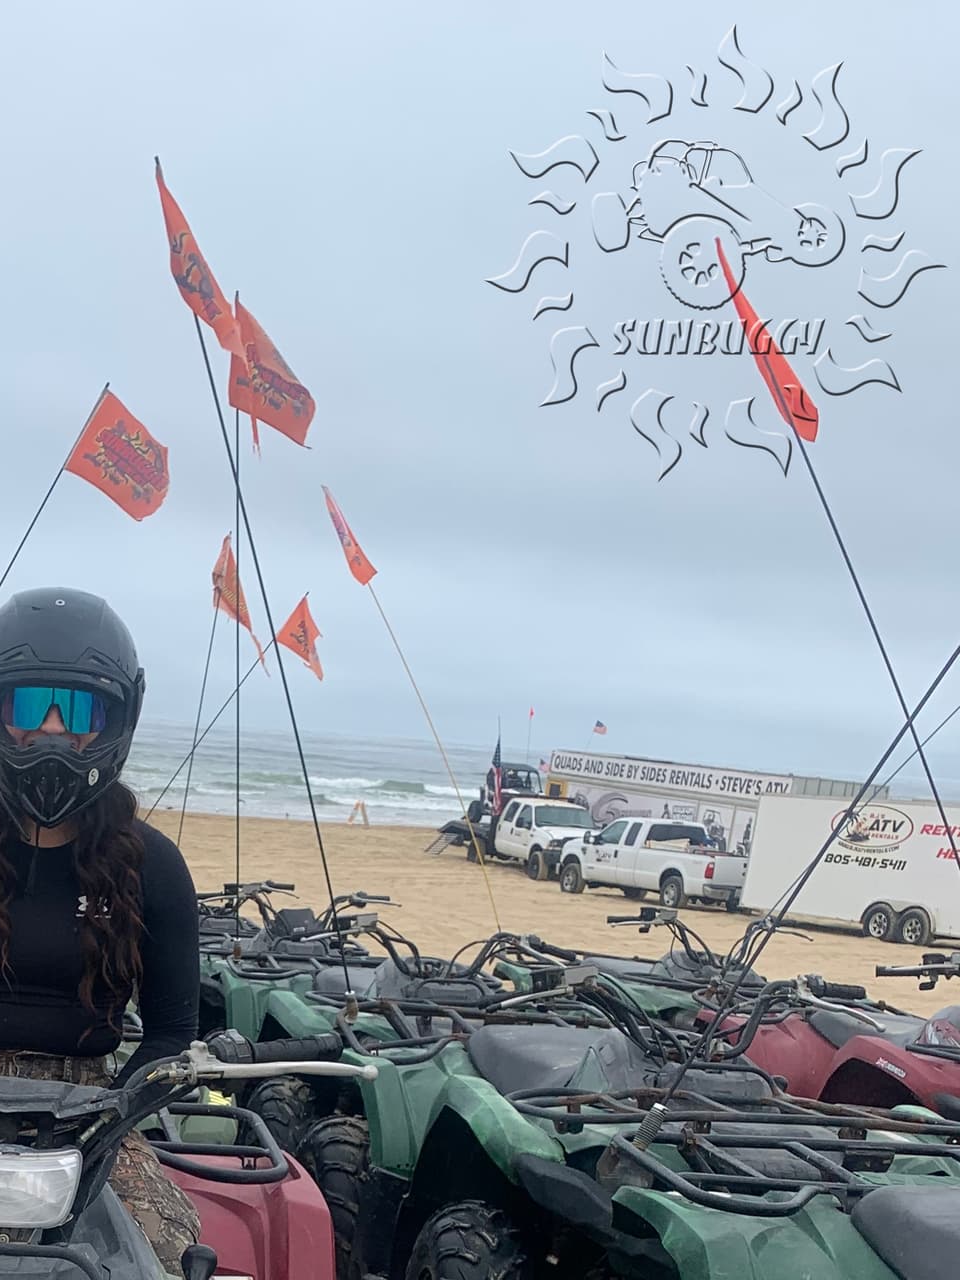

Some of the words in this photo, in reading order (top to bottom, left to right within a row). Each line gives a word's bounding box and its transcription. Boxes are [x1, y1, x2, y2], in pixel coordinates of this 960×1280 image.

[554, 754, 583, 771] QUADS
[583, 759, 603, 774] AND
[605, 761, 626, 777] SIDE
[626, 764, 640, 779] BY
[640, 765, 667, 783] SIDES
[669, 769, 713, 789] RENTALS
[720, 775, 763, 796] STEVE'S
[869, 819, 905, 833] ATV
[871, 832, 899, 841] RENTALS
